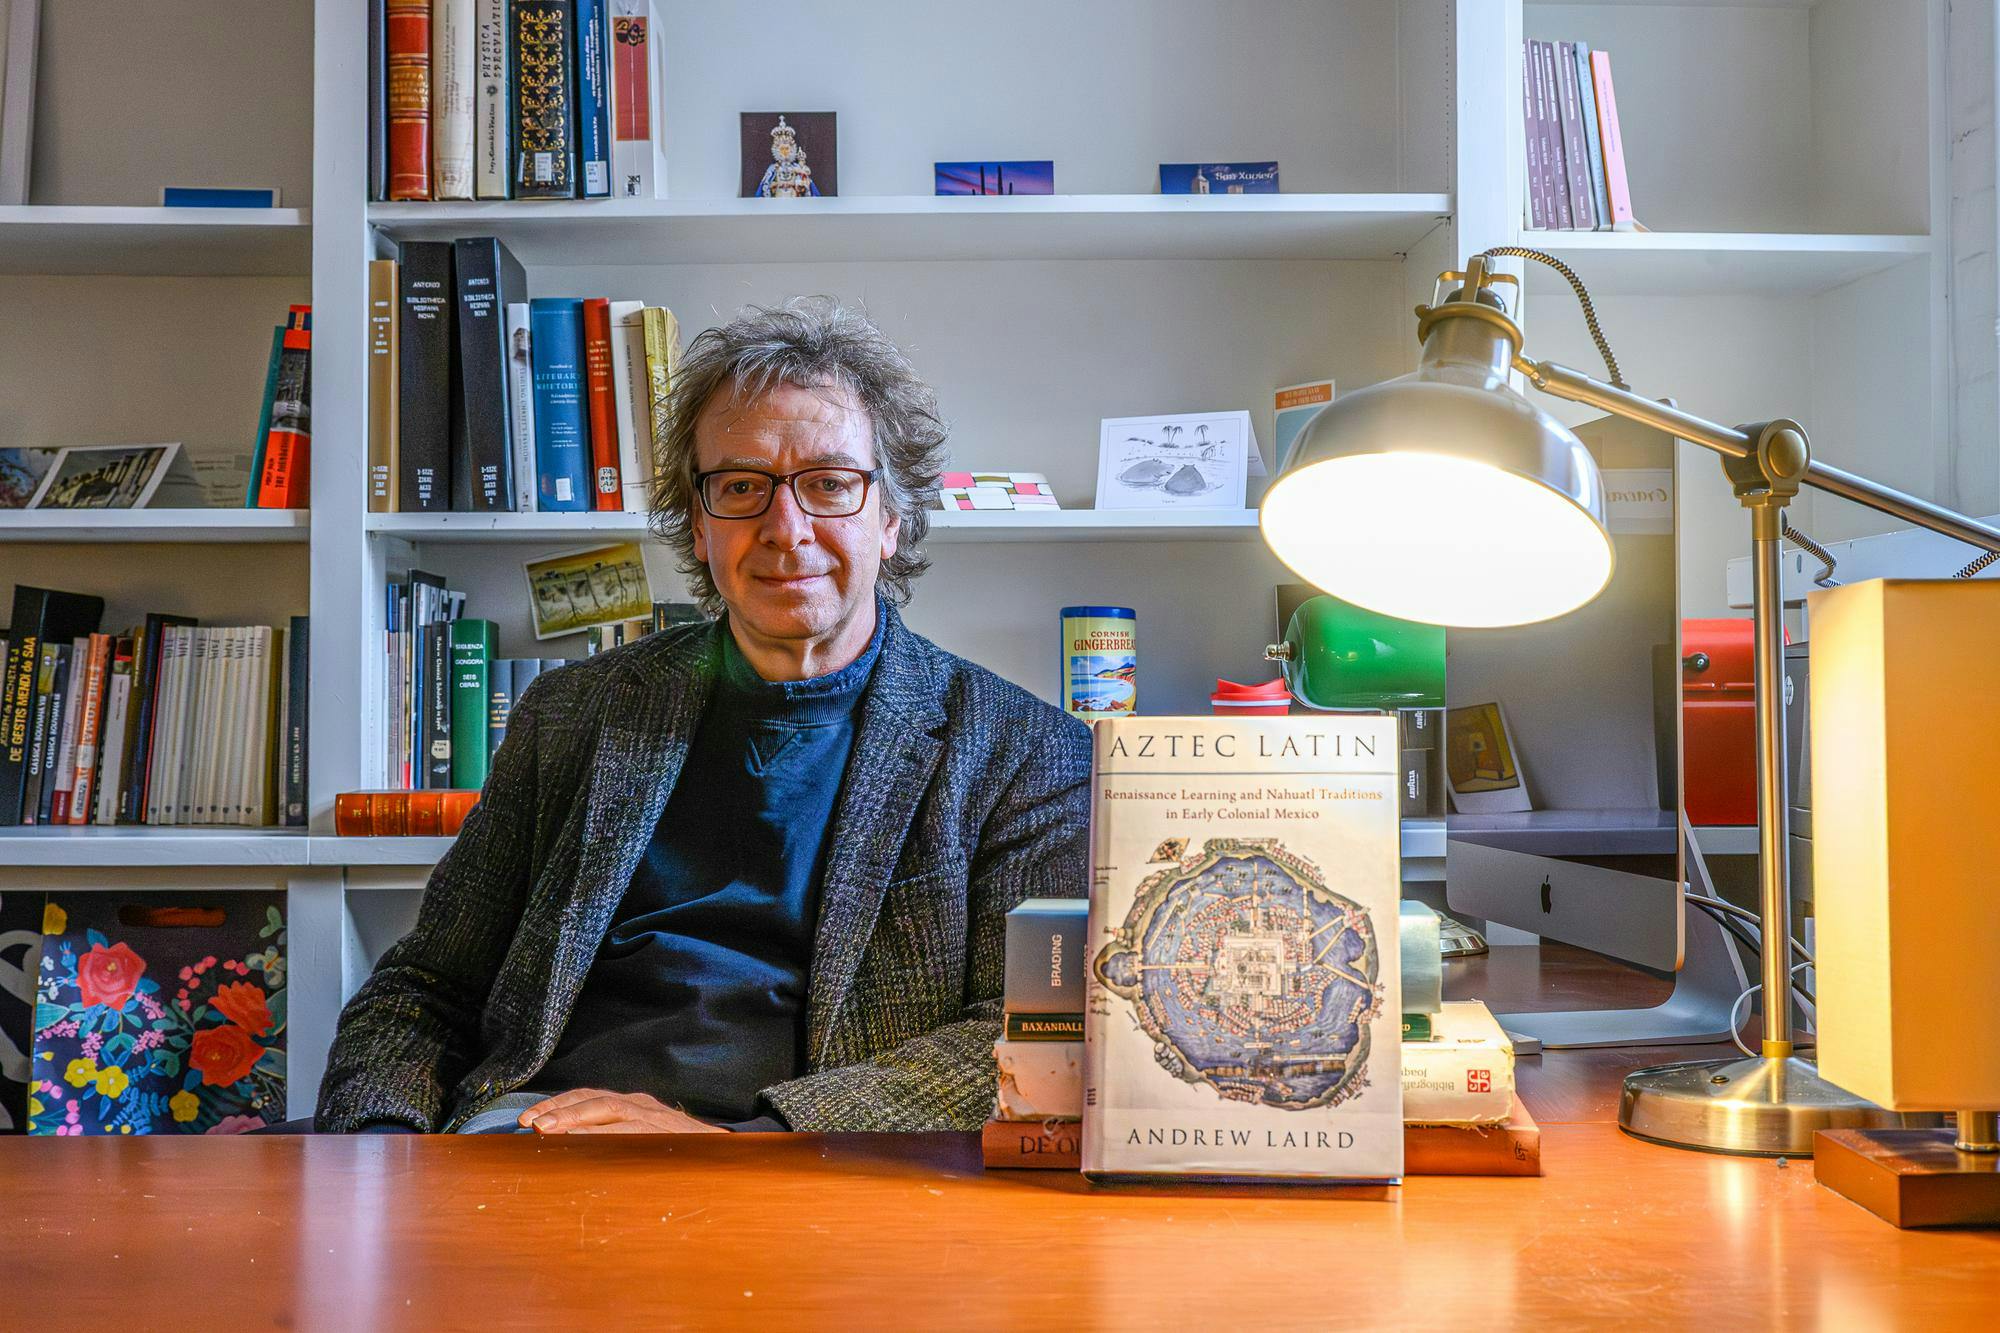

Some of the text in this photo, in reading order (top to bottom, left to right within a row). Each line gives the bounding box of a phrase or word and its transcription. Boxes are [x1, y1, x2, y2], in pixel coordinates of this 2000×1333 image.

[482, 24, 491, 78] PHYSICA
[468, 278, 490, 286] ANTONIO
[406, 296, 446, 304] BIBLIOTHECA
[464, 293, 495, 302] BIBLIOTHECA
[474, 309, 487, 317] NOVA
[1074, 639, 1136, 651] GINGERBREA
[10, 637, 36, 762] DE GESTIS MENDI de SAA
[46, 737, 56, 768] CLASSICA
[1110, 734, 1377, 758] AZTEC LATIN
[31, 743, 41, 775] CLASSICA
[1407, 770, 1415, 799] LAVAZZA
[1104, 788, 1383, 803] Renaissance Learning and Nahuatl Traditions
[1165, 808, 1320, 823] in Early Colonial Mexico
[1051, 933, 1063, 987] BRADING
[1021, 1022, 1084, 1032] BAXANDALL
[1020, 1135, 1081, 1156] DE O
[1128, 1128, 1356, 1150] ANDREW LAIRD
